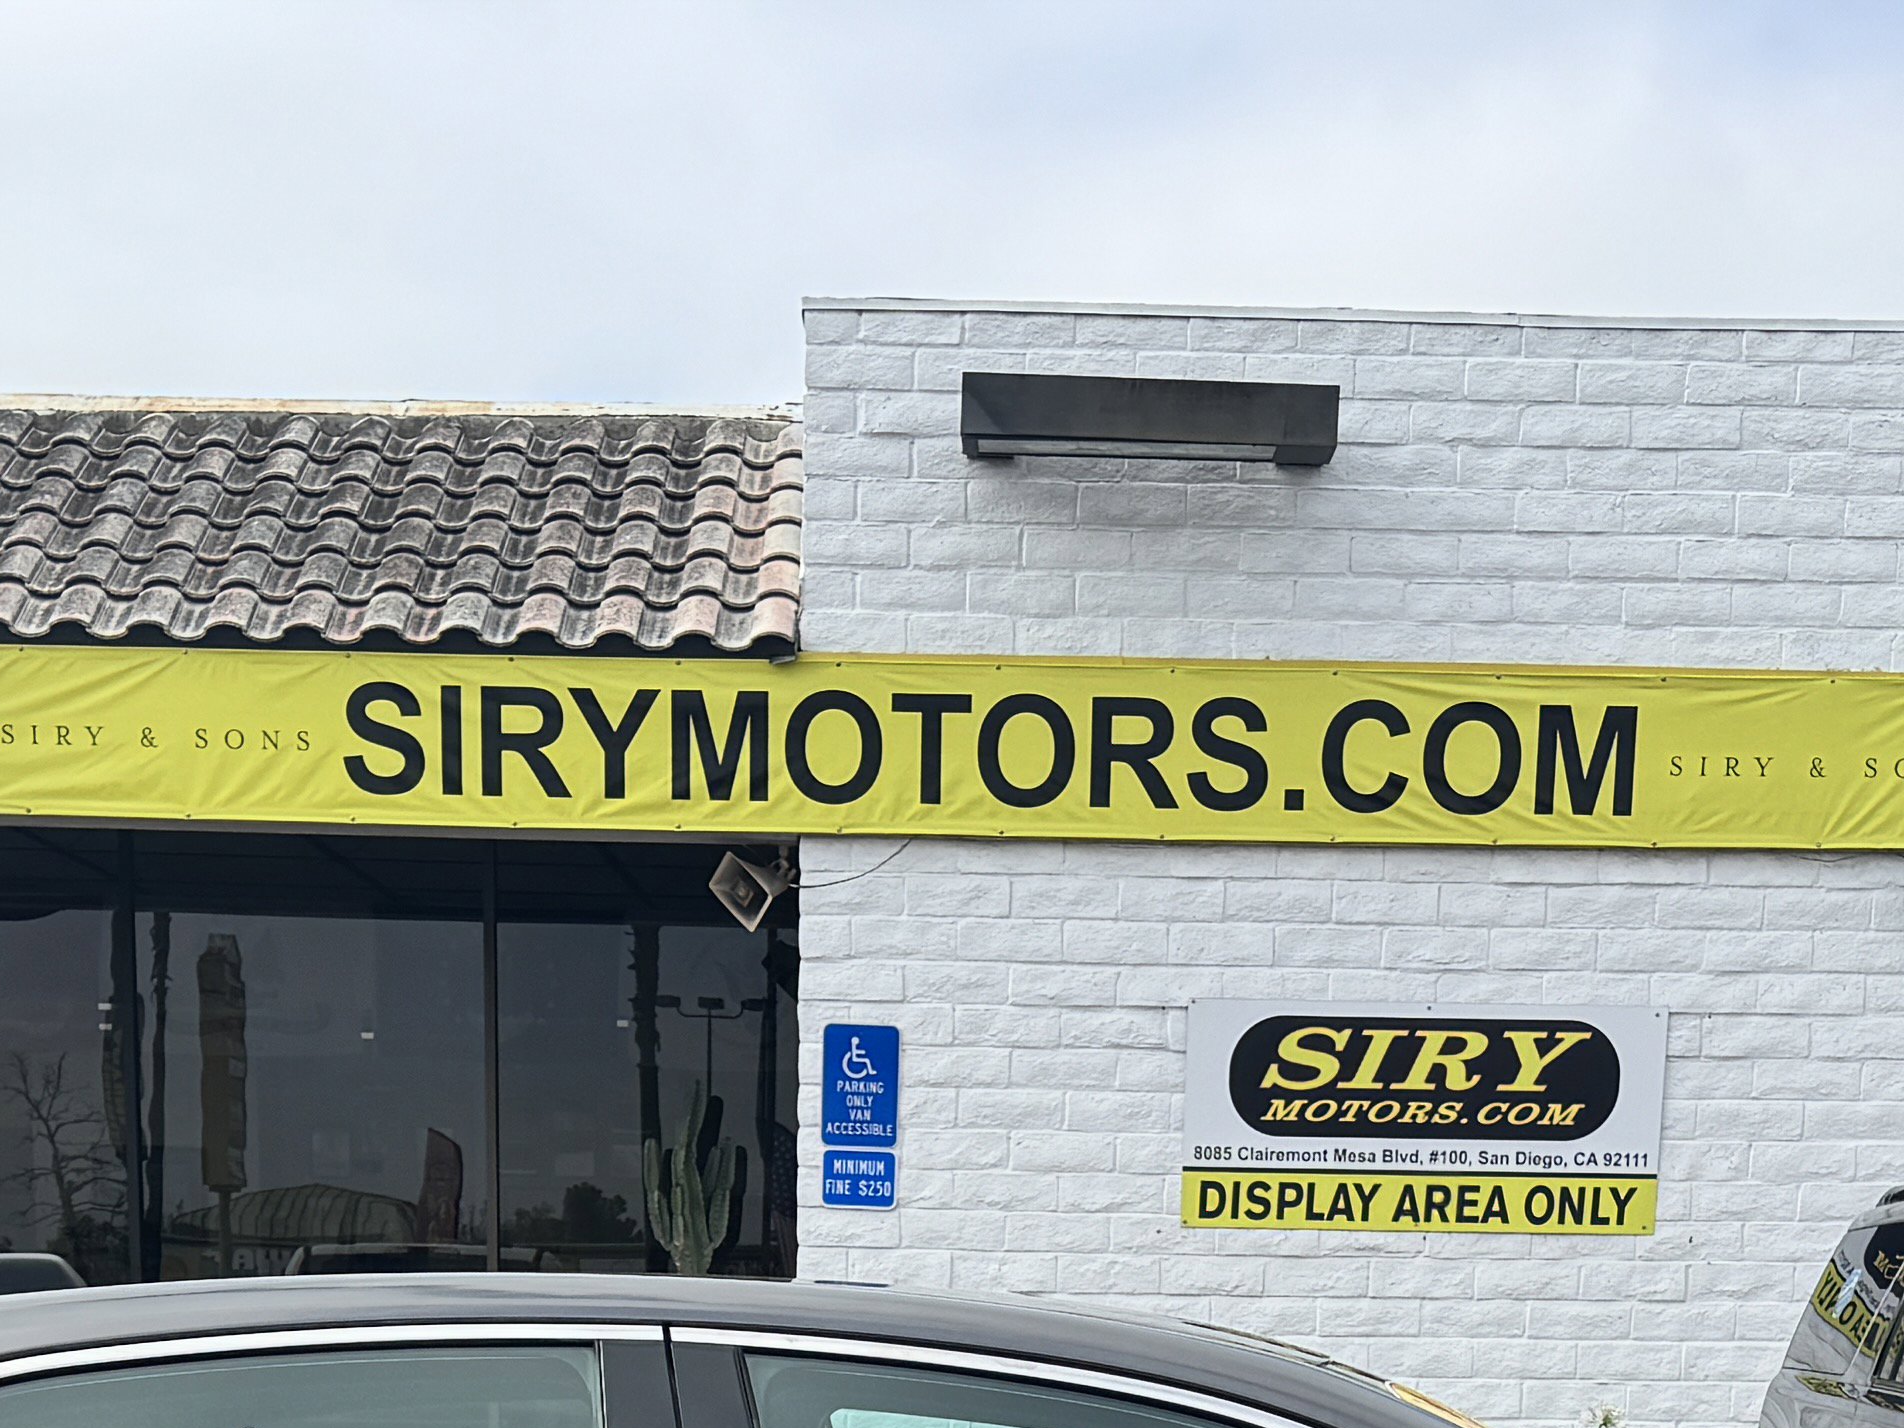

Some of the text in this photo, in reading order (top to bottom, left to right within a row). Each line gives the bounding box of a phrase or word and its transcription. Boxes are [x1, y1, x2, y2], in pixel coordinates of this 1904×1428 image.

[1, 723, 313, 752] SIRY & SONS
[343, 681, 1639, 818] SIRYMOTORS.COM
[1669, 755, 1777, 778] SIRY
[1809, 757, 1827, 778] &
[1259, 1026, 1592, 1092] SIRY
[836, 1080, 885, 1095] PARKING
[846, 1095, 874, 1108] ONLY
[1260, 1099, 1585, 1126] MOTORS.COM
[848, 1109, 872, 1121] VAN
[825, 1122, 894, 1137] ACCESSIBLE
[833, 1159, 885, 1177] MINIMUM
[1193, 1146, 1649, 1169] 8085 Clairemont Mesa Blvd, #100, San Diego, CA 92111
[825, 1179, 892, 1198] FINE $250
[1198, 1180, 1639, 1227] DISPLAY AREA ONLY
